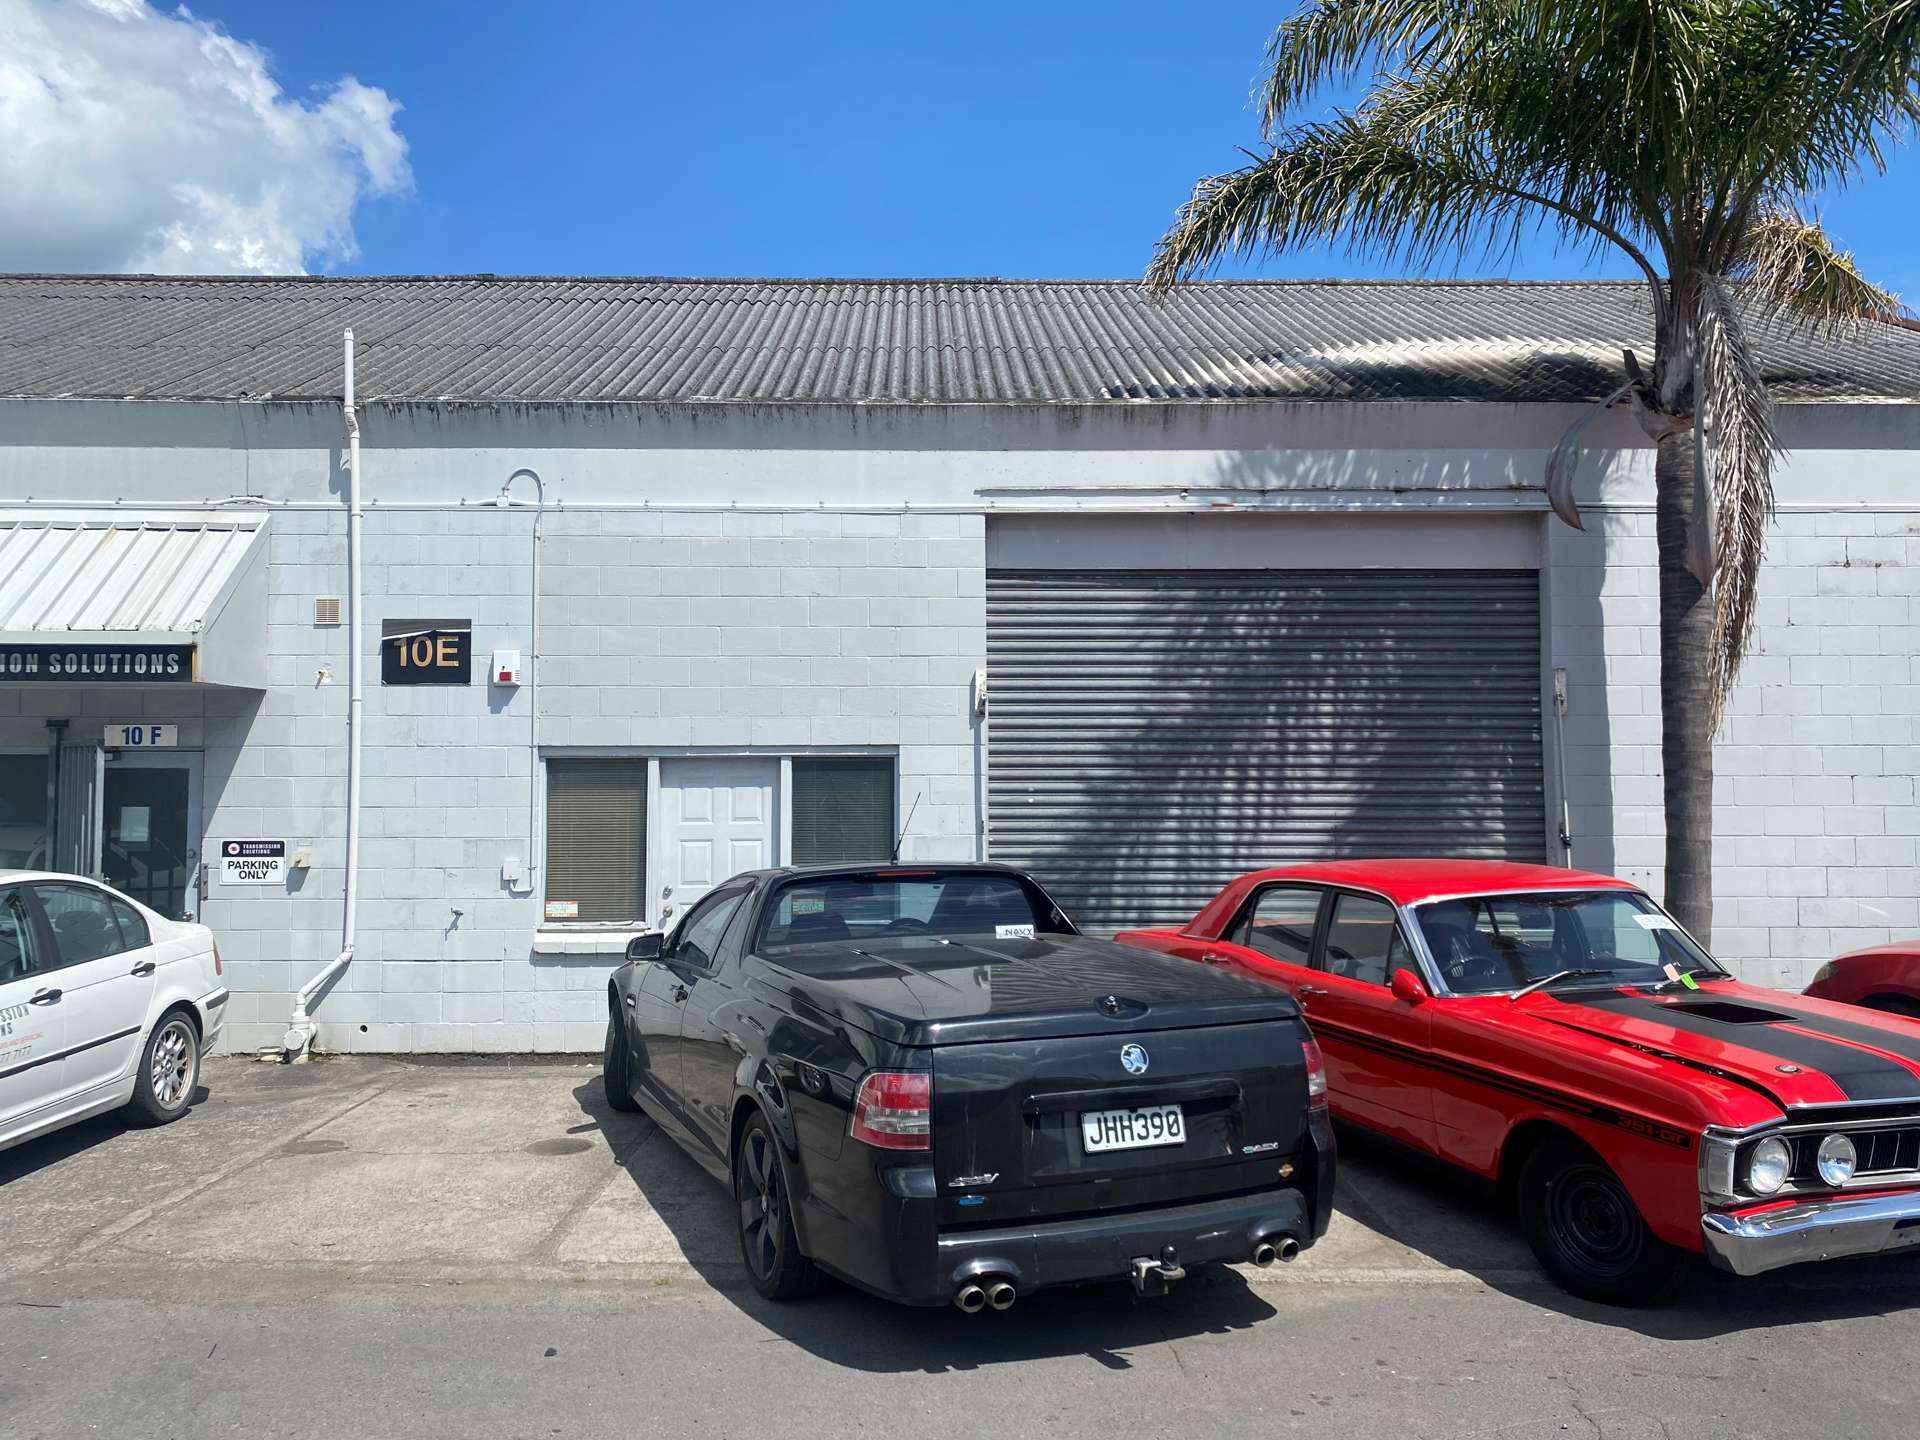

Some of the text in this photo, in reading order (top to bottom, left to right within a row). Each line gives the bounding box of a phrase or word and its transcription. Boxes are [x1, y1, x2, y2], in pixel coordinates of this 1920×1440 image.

[393, 635, 460, 667] 10E
[49, 653, 179, 674] SOLUTIONS
[121, 726, 162, 745] 10 F
[227, 860, 279, 870] PARKING
[238, 870, 269, 880] ONLY
[1090, 1110, 1181, 1145] JHH390
